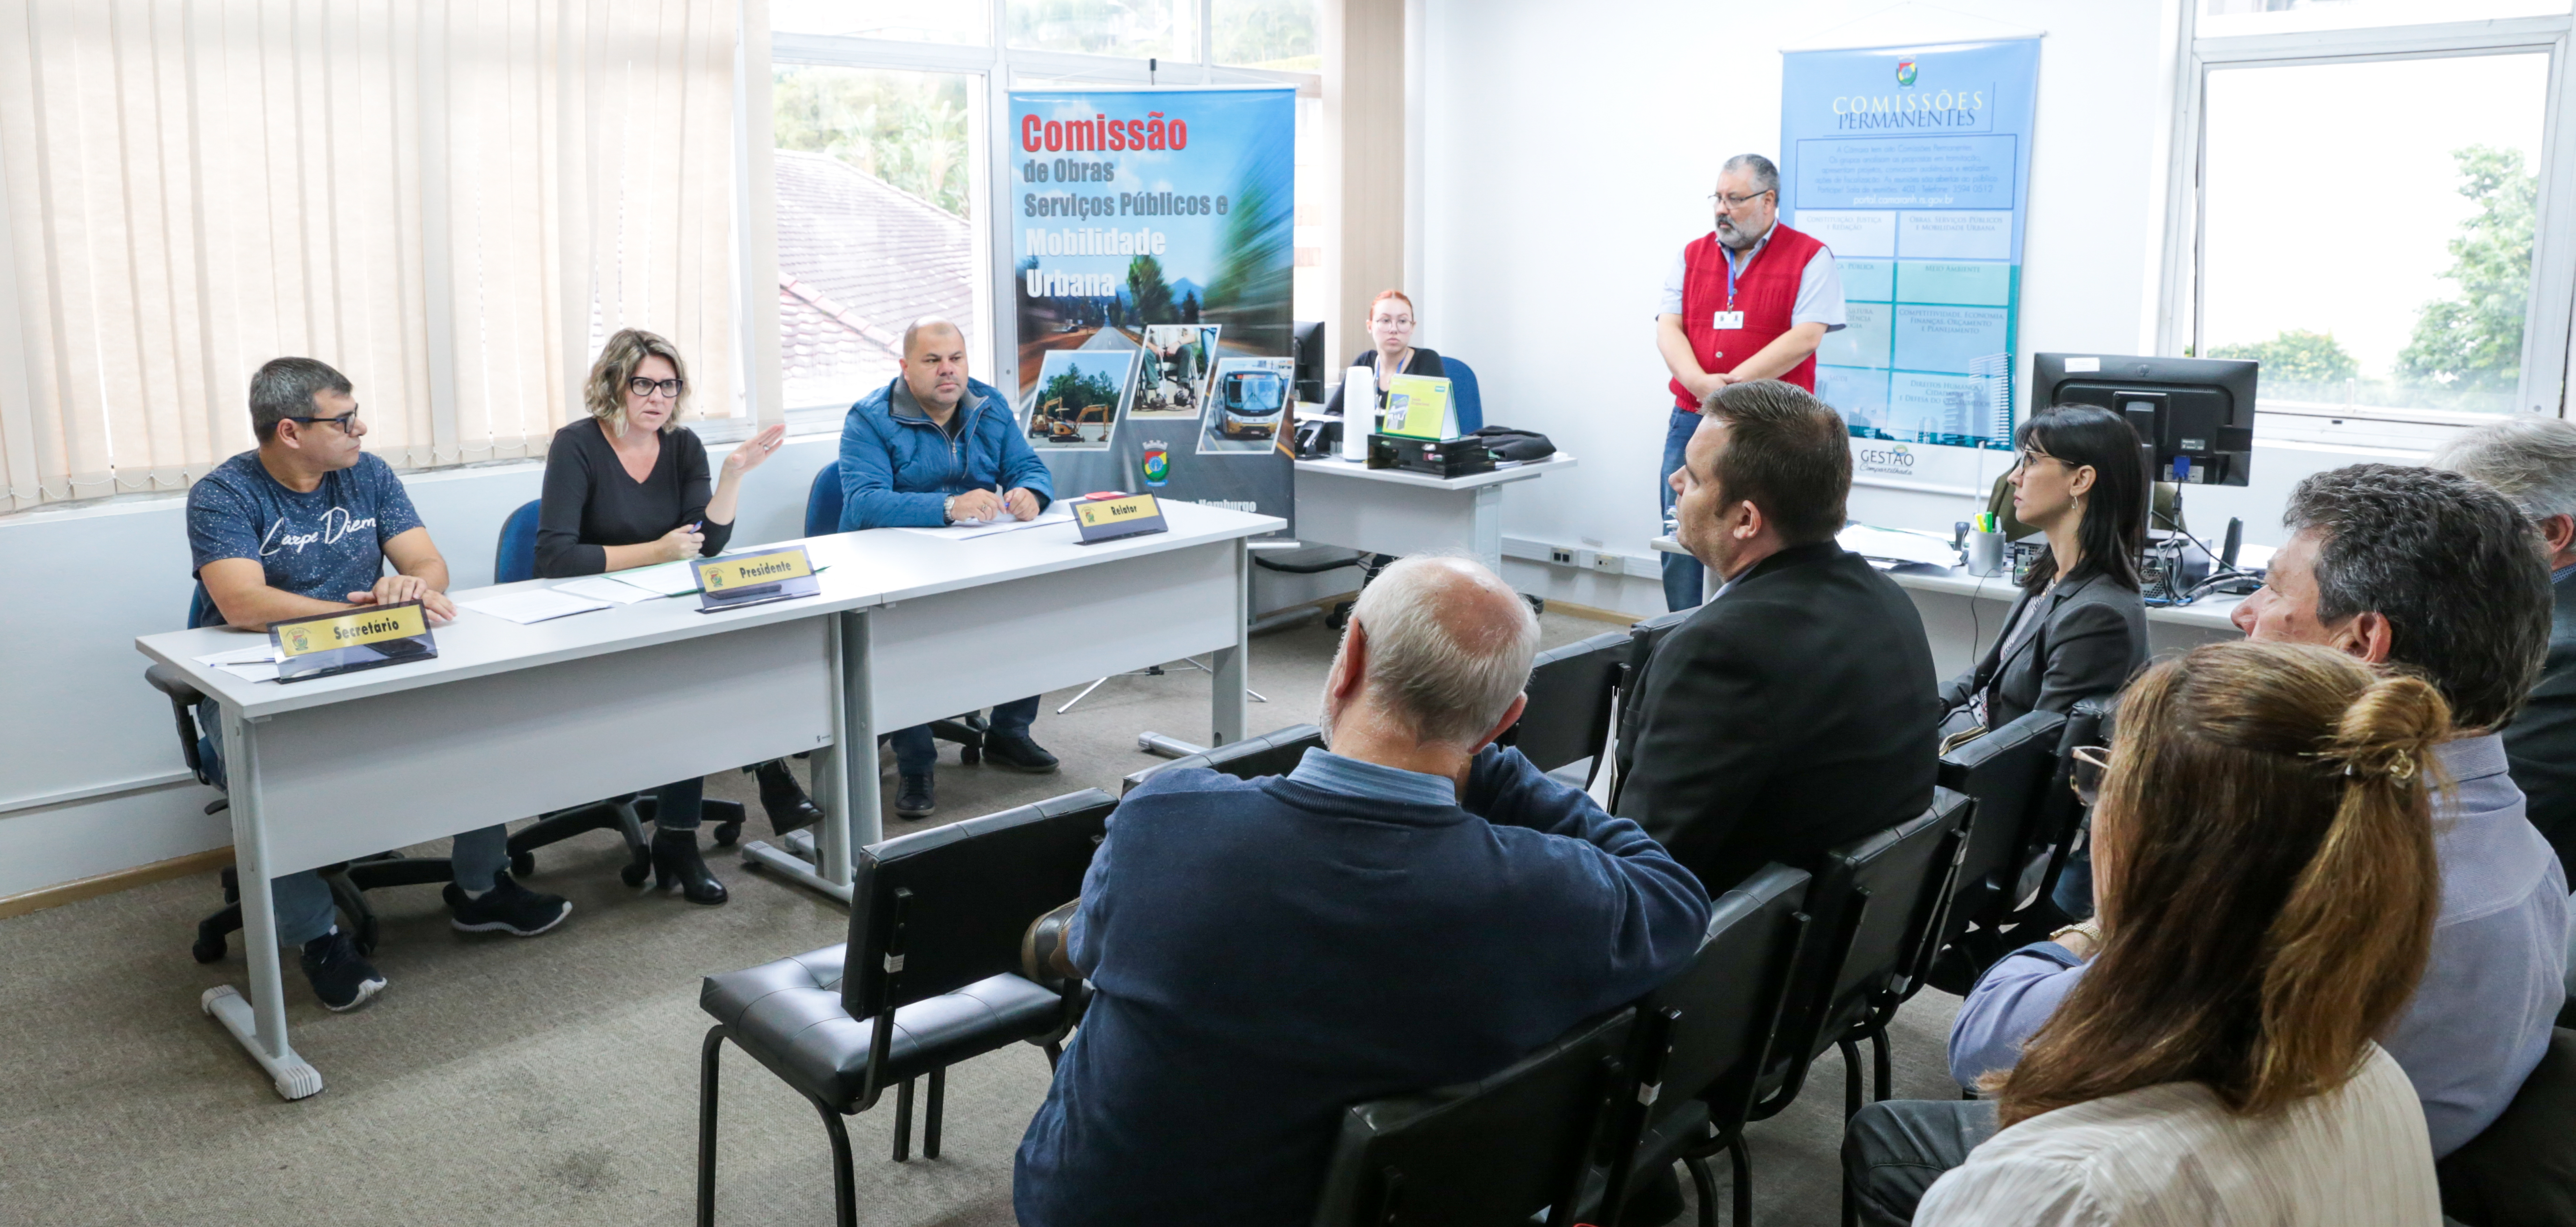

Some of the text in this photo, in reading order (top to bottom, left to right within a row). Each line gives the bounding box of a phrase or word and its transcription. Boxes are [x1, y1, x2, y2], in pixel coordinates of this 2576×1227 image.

[1833, 89, 1982, 114] COMISSÕES
[1839, 108, 1975, 129] PERMANENTES
[1022, 111, 1187, 152] Comissão
[1023, 158, 1114, 182] de Obras
[1024, 192, 1228, 221] Serviços Públicos e
[1853, 193, 1954, 207] portal.camaranh.rs.gov.br
[1026, 228, 1165, 256] Mobilidade
[1027, 269, 1116, 298] Urbana
[1110, 505, 1137, 515] Relator
[259, 506, 377, 556] Carpe Diem
[739, 561, 792, 579] Presidente
[334, 617, 399, 640] Secretário
